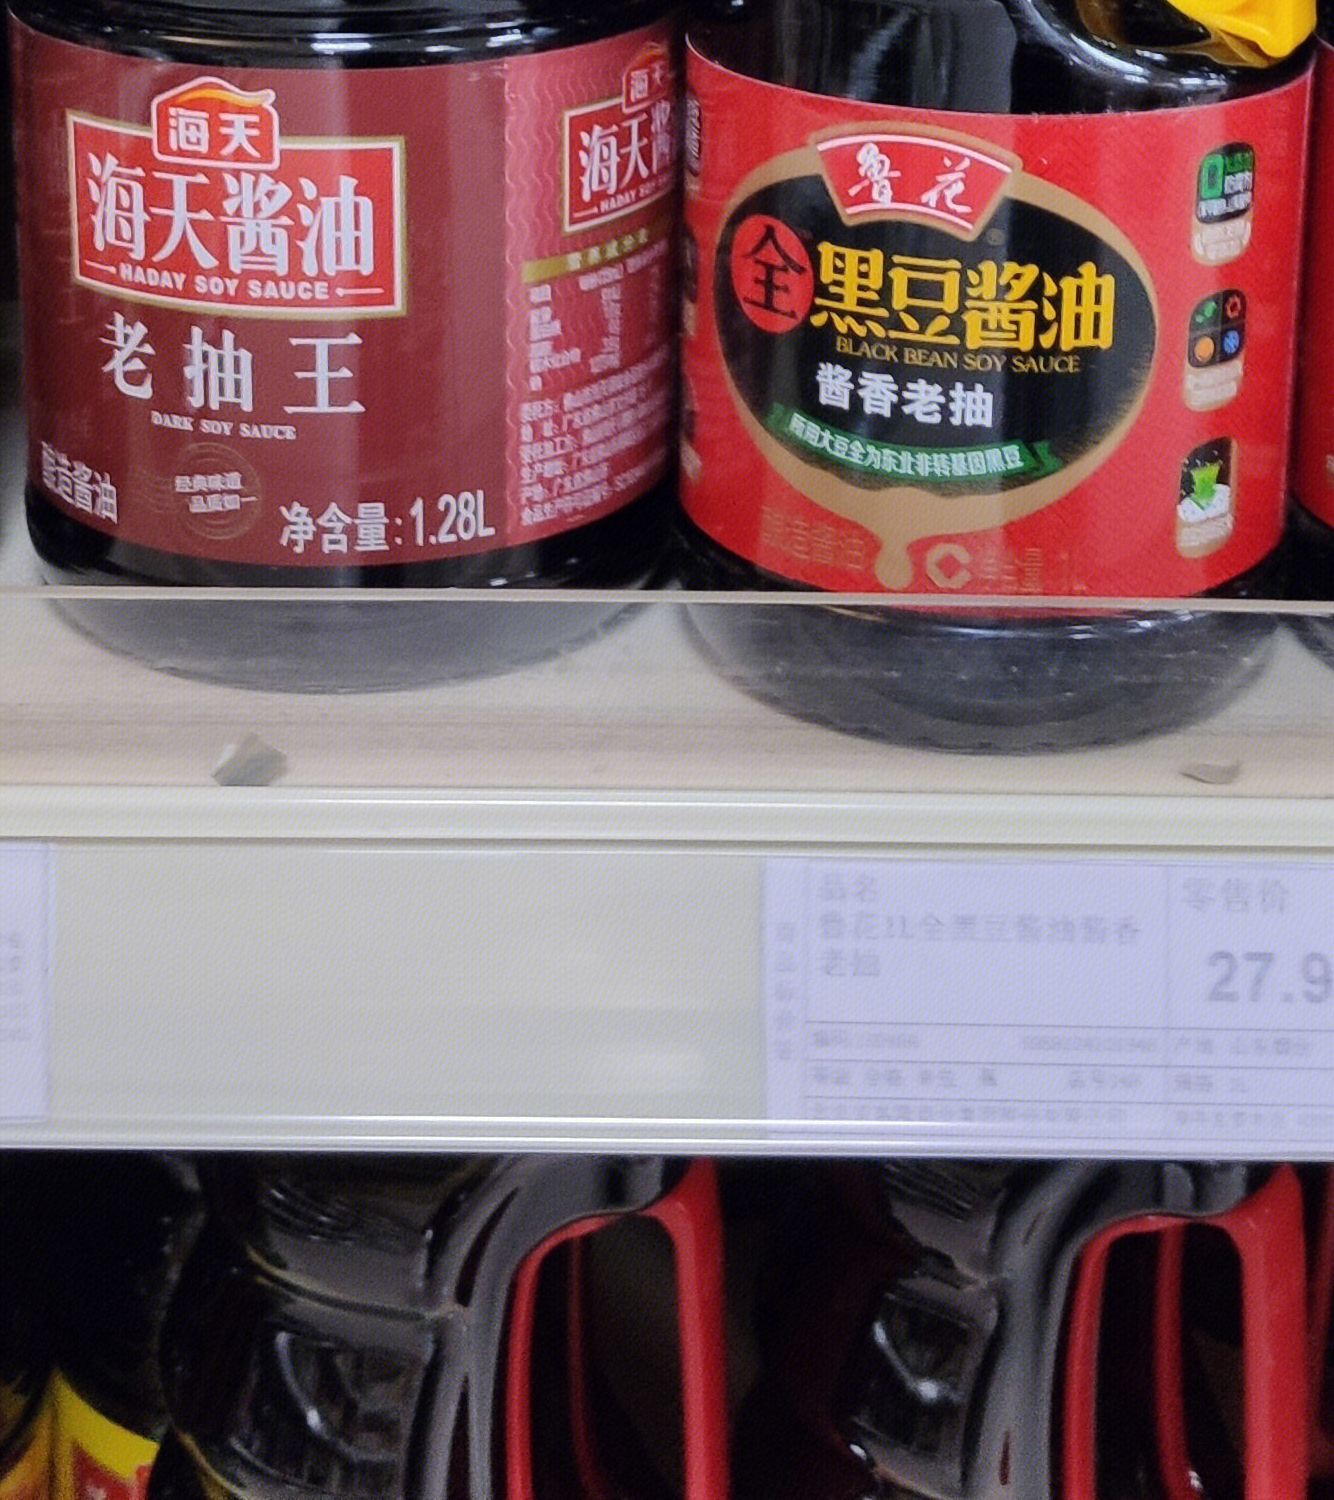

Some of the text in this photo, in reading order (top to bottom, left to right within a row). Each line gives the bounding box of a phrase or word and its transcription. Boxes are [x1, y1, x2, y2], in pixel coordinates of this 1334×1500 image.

[169, 106, 263, 159] 海天
[847, 141, 973, 214] 鲁花
[87, 151, 375, 278] 海天酱油
[118, 262, 330, 301] HADAY SOY SAUCE
[740, 224, 807, 318] 全
[809, 239, 1115, 352] 黑豆酱油
[98, 310, 367, 416] 老抽王
[835, 336, 1083, 375] BLACK BEAN SOY SAUCE
[815, 361, 995, 429] 酱香老抽
[150, 410, 298, 441] DARK SOY SAUCE
[1179, 874, 1291, 915] 零售价
